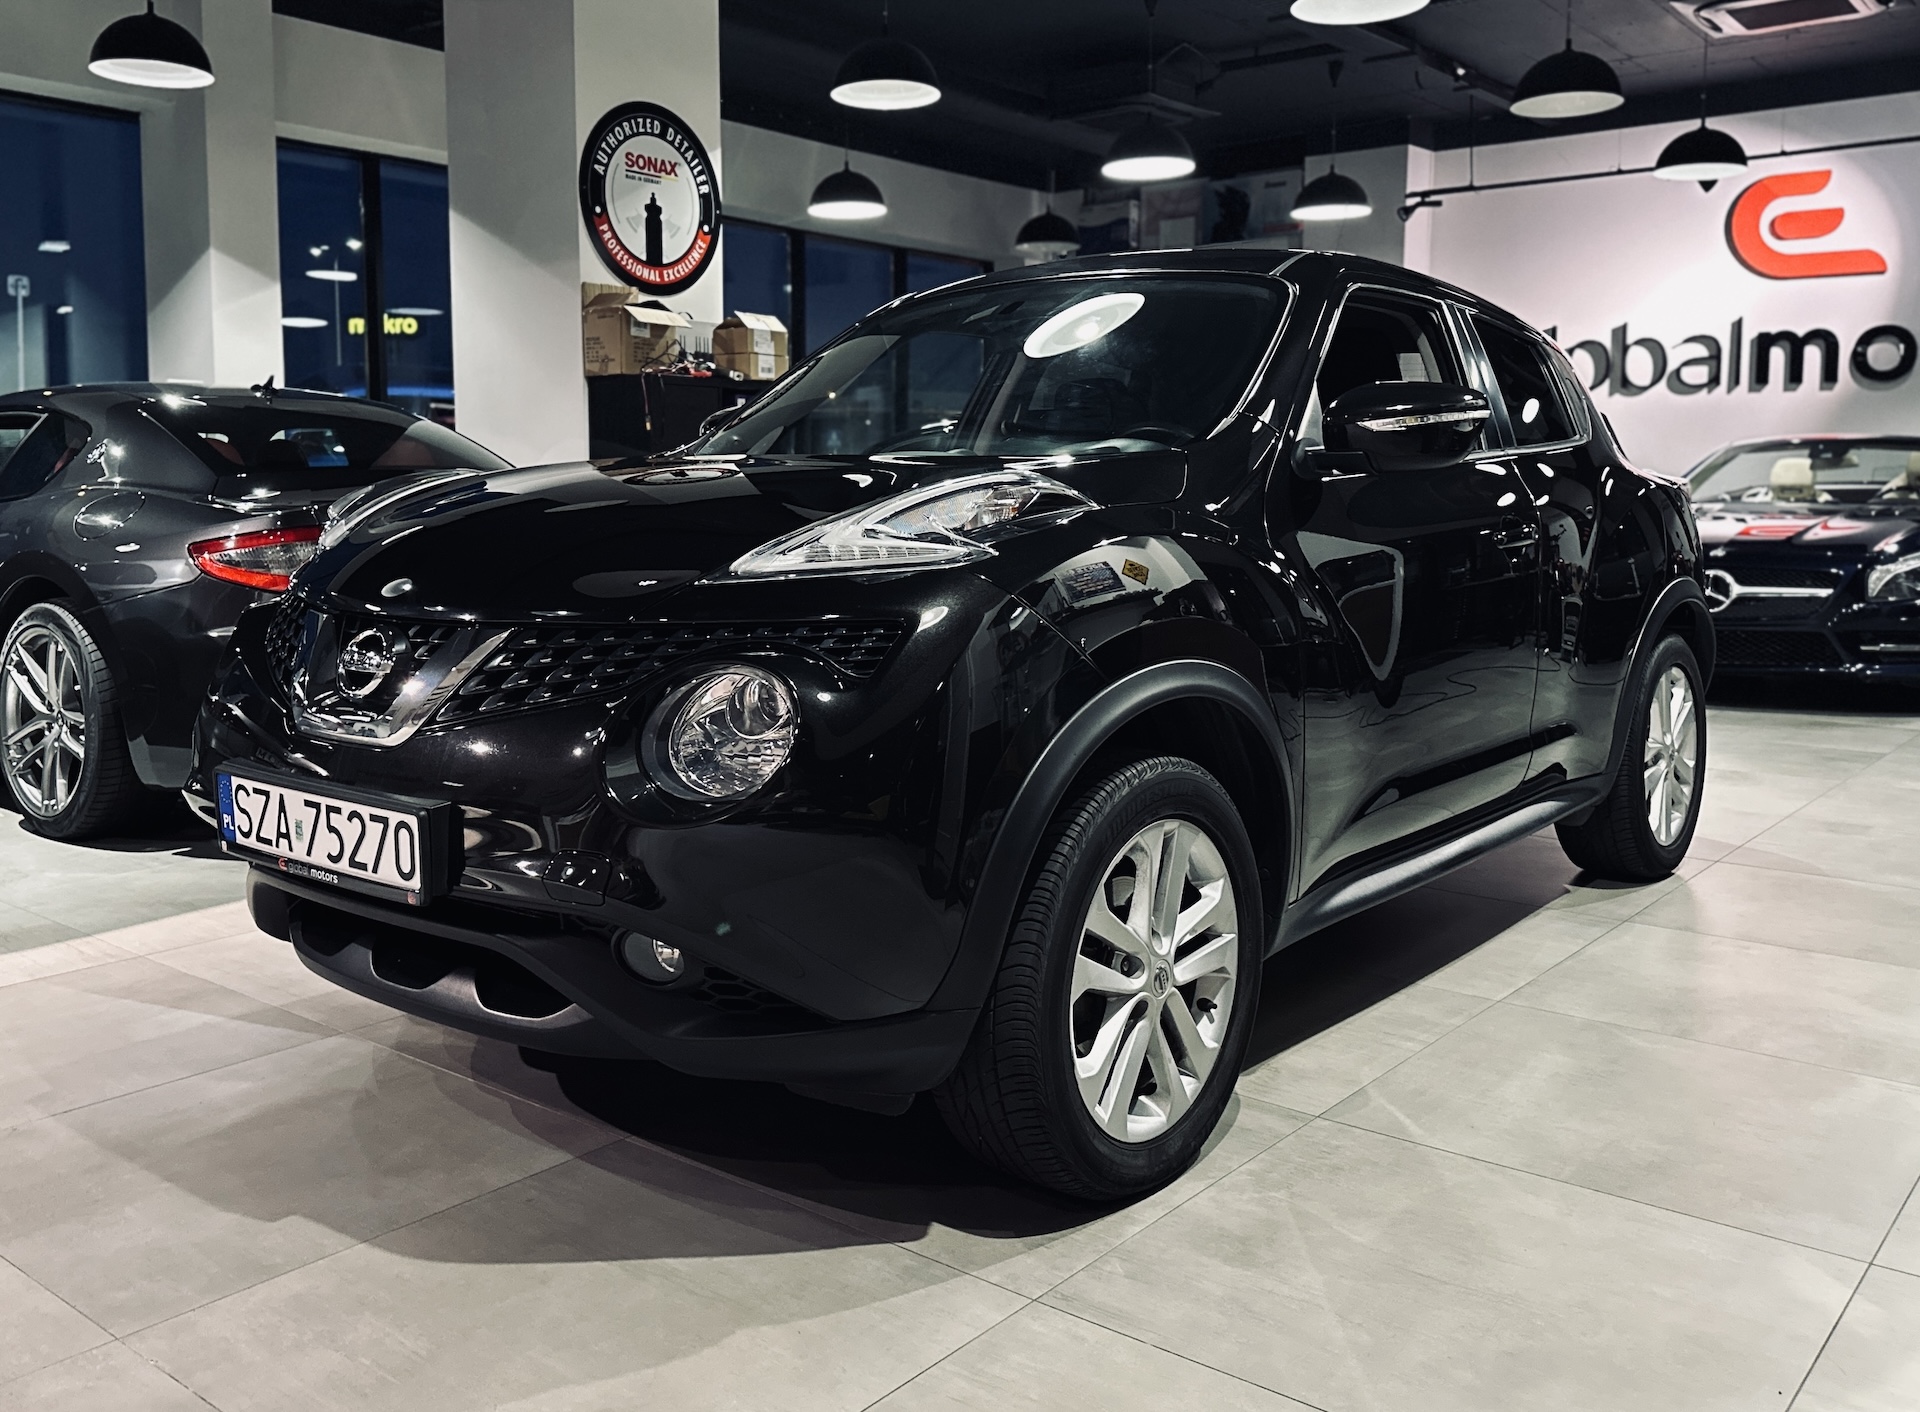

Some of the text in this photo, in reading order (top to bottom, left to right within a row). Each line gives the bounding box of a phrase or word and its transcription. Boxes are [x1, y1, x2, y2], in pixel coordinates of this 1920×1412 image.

[594, 118, 709, 194] AUTHORIZED DETAILER
[624, 151, 679, 178] SONAX
[600, 223, 706, 282] PROFESSIONAL EXCELLENCE
[348, 312, 418, 334] mkro
[1543, 316, 1918, 397] obalmo
[223, 813, 235, 831] PL
[234, 783, 416, 881] SZA 75270
[310, 868, 339, 884] motors
